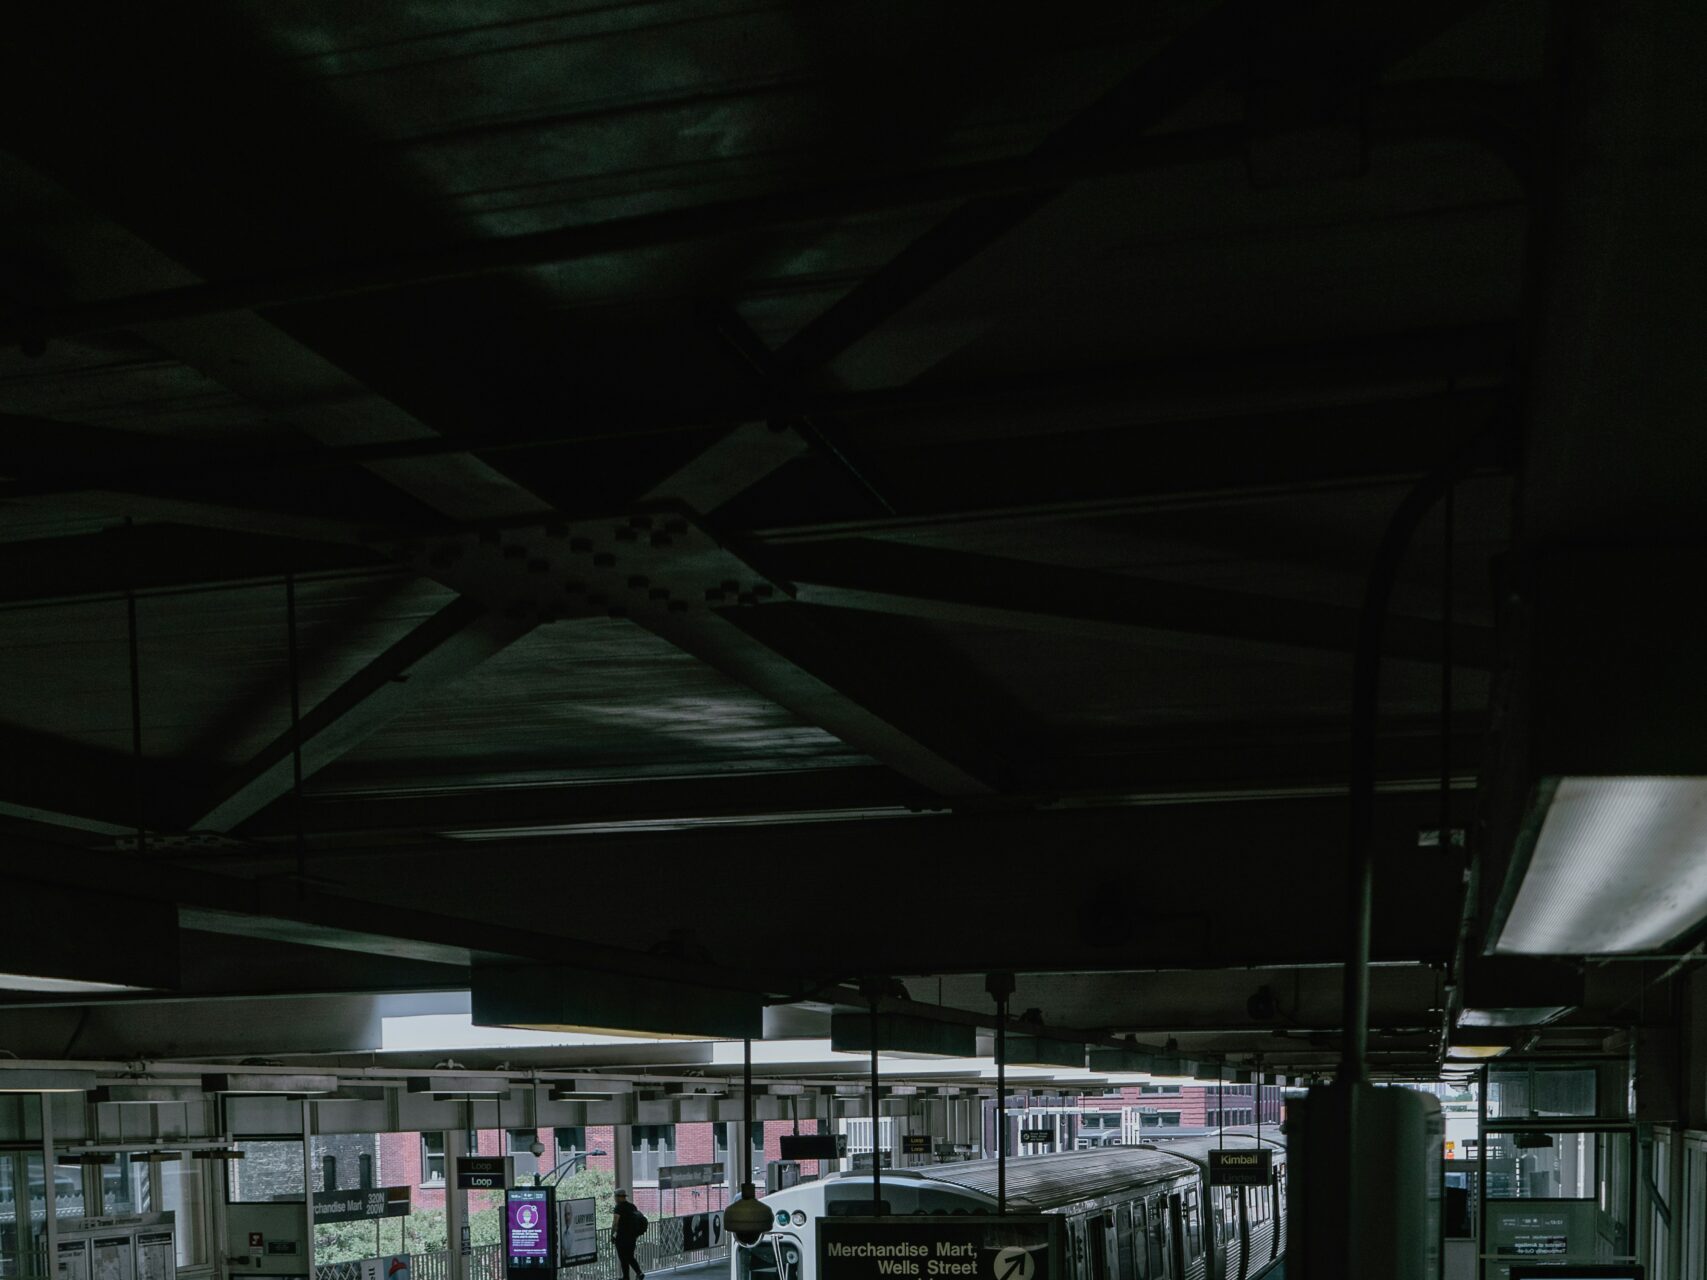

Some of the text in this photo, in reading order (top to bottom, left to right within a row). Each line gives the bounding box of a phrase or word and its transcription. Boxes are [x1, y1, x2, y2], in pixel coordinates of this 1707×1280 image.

[1221, 1154, 1258, 1165] Kimball
[471, 1176, 493, 1187] Loop
[367, 1192, 385, 1204] 320N
[313, 1200, 362, 1215] rchandise Mart
[366, 1203, 385, 1215] 200W
[828, 1242, 978, 1259] Merchandise Mart,
[878, 1259, 978, 1274] Wells Street
